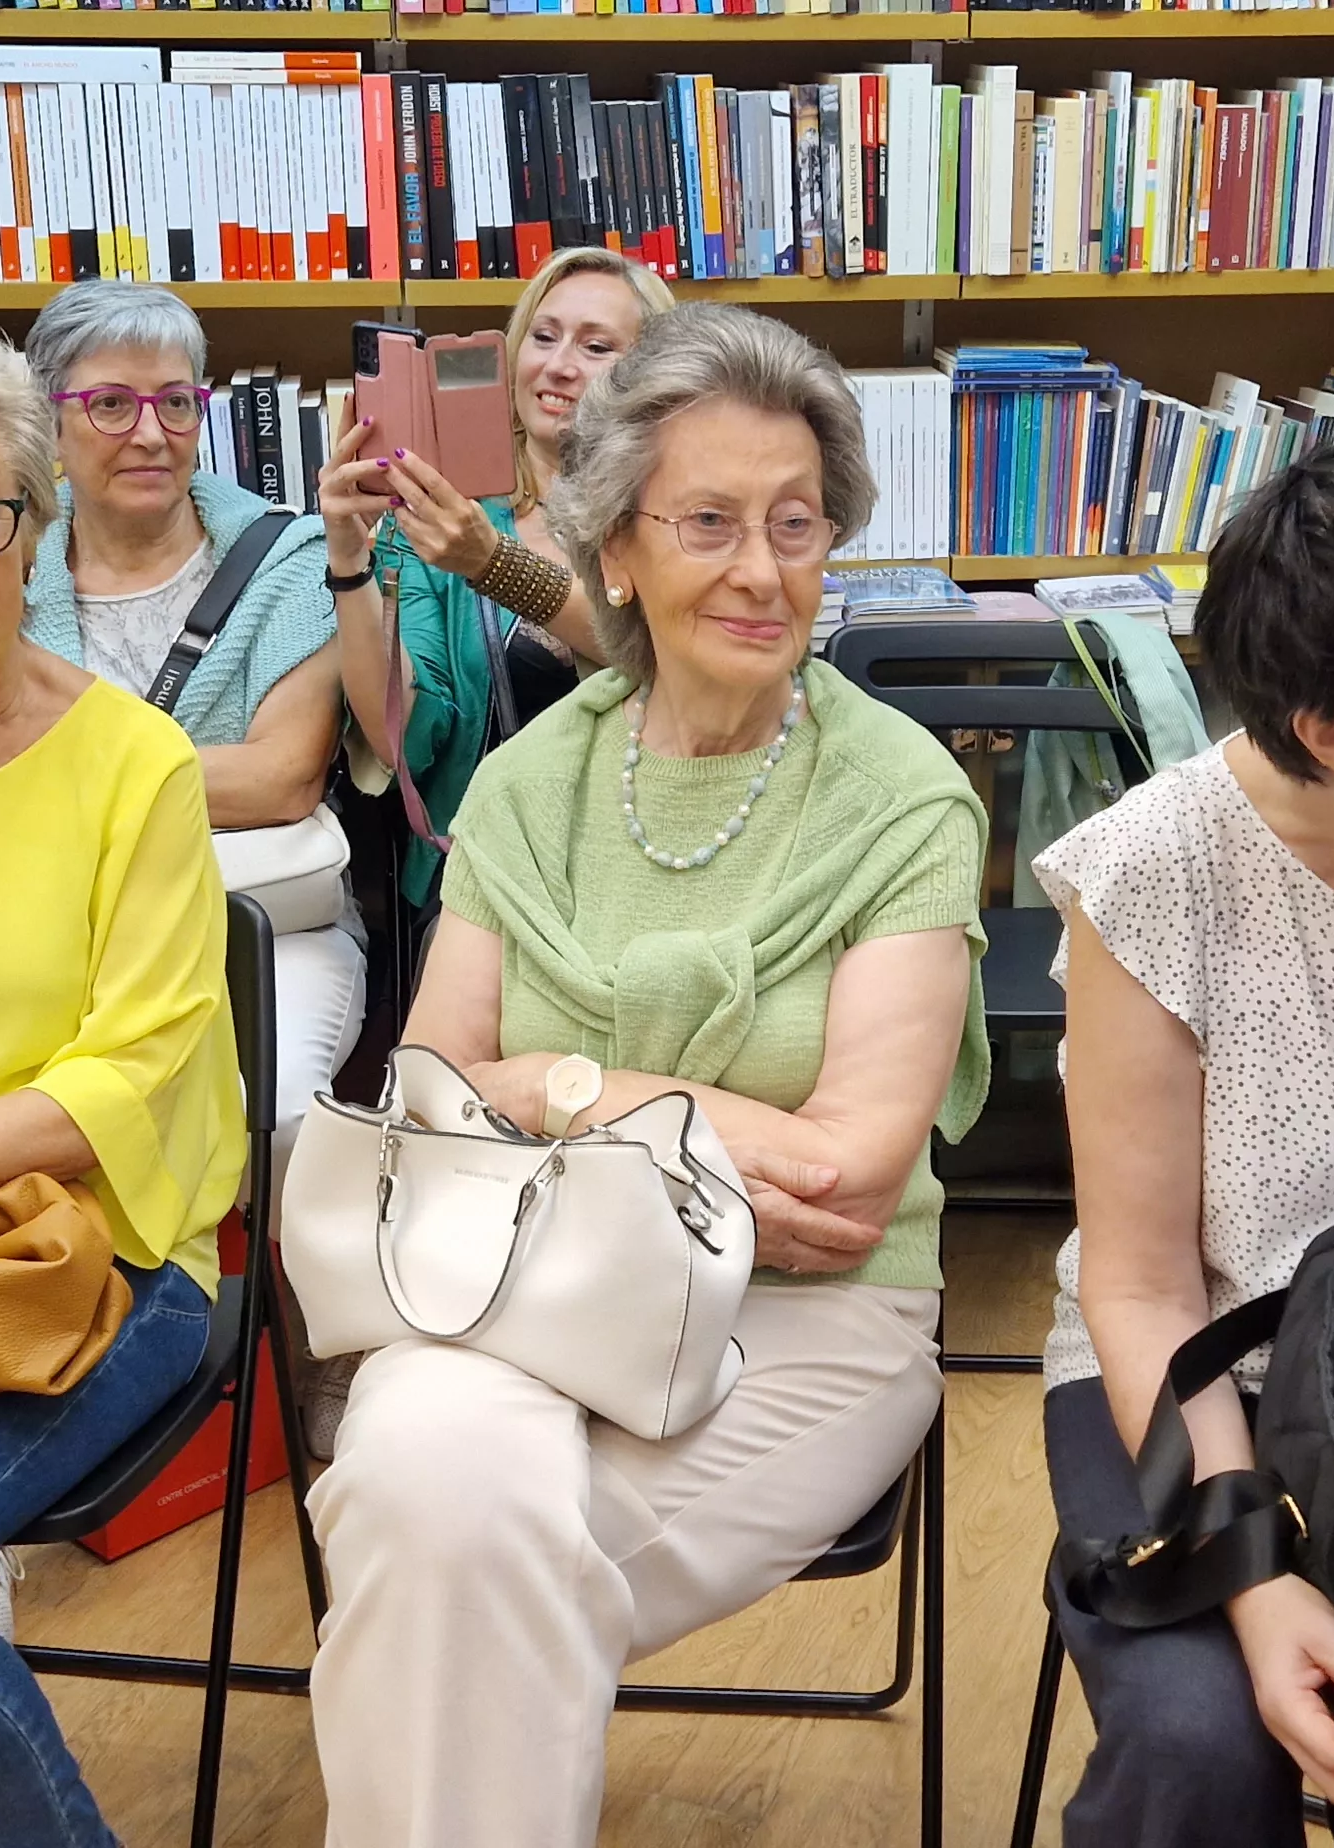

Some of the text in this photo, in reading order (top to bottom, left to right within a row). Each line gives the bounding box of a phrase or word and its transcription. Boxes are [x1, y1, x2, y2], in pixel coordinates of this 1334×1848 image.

[427, 84, 442, 112] HORST
[400, 86, 418, 164] JOHN VERDON
[1220, 116, 1230, 161] HERNÁNDEZ
[1240, 113, 1249, 151] MACHADO
[432, 148, 445, 159] DE
[433, 160, 446, 188] FUEGO
[849, 143, 858, 219] EL TRADUCTOR
[404, 173, 424, 245] EL FAVOR
[253, 387, 274, 436] JOHN
[262, 463, 280, 504] GRIS
